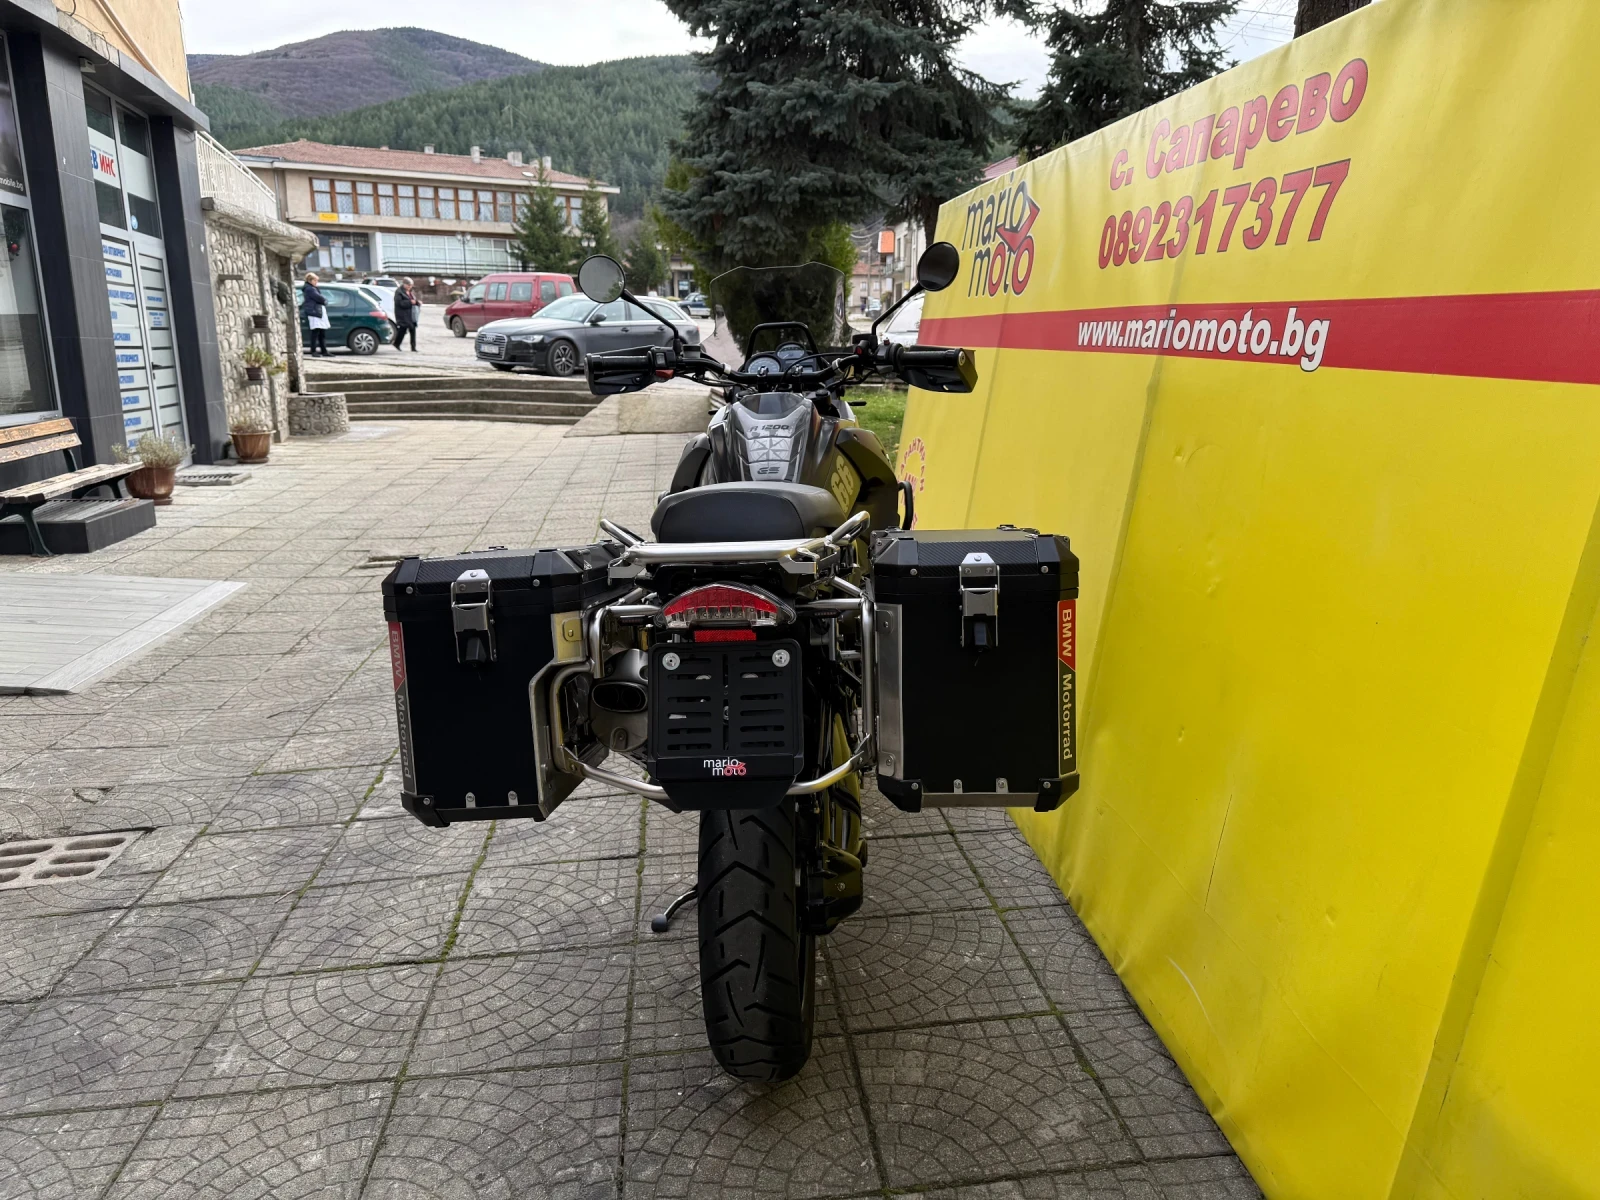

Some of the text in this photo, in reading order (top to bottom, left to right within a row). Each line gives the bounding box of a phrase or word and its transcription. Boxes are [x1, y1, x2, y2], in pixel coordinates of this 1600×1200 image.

[1109, 57, 1369, 191] с. Сапарево
[99, 152, 116, 178] ИНС
[961, 171, 1028, 251] mario
[1098, 158, 1351, 270] 0892317377
[967, 234, 1035, 297] moto
[1077, 306, 1331, 373] www.mariomoto.bg
[757, 466, 781, 475] GS
[391, 630, 412, 779] BMW Motorrad
[1062, 608, 1073, 760] BMW Motorrad
[703, 756, 739, 769] mario
[712, 766, 747, 777] moto
